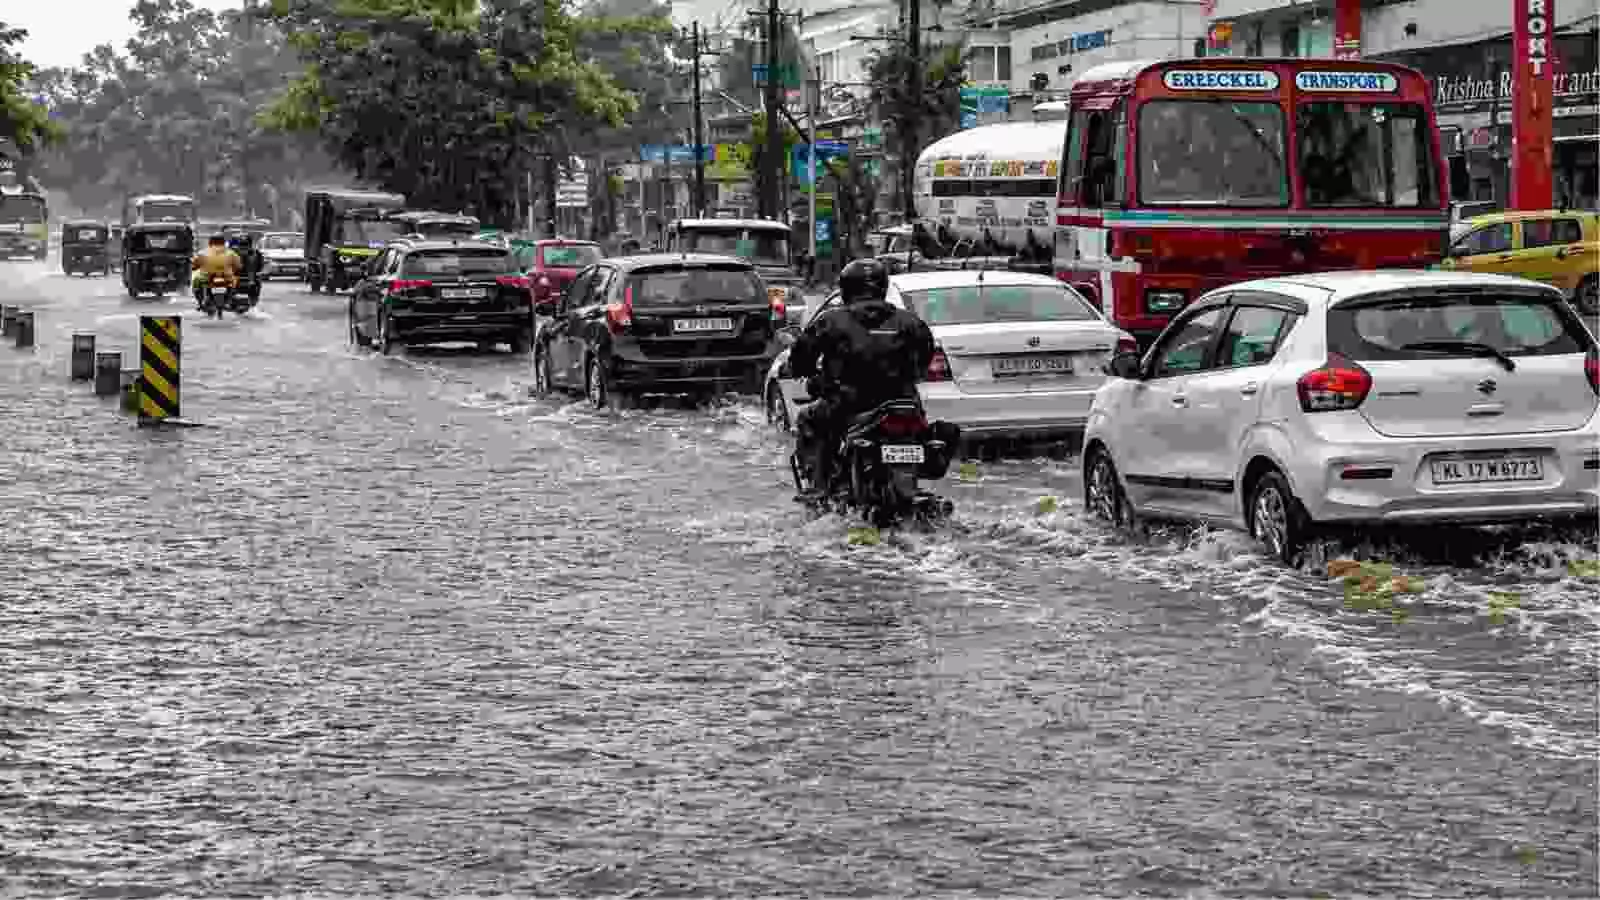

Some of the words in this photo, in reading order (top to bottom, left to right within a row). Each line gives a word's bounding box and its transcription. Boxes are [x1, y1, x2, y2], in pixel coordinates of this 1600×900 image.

[1300, 73, 1387, 89] TRANSPORT
[1437, 75, 1494, 104] Krishna
[1443, 464, 1463, 477] KL
[1470, 463, 1481, 477] 17
